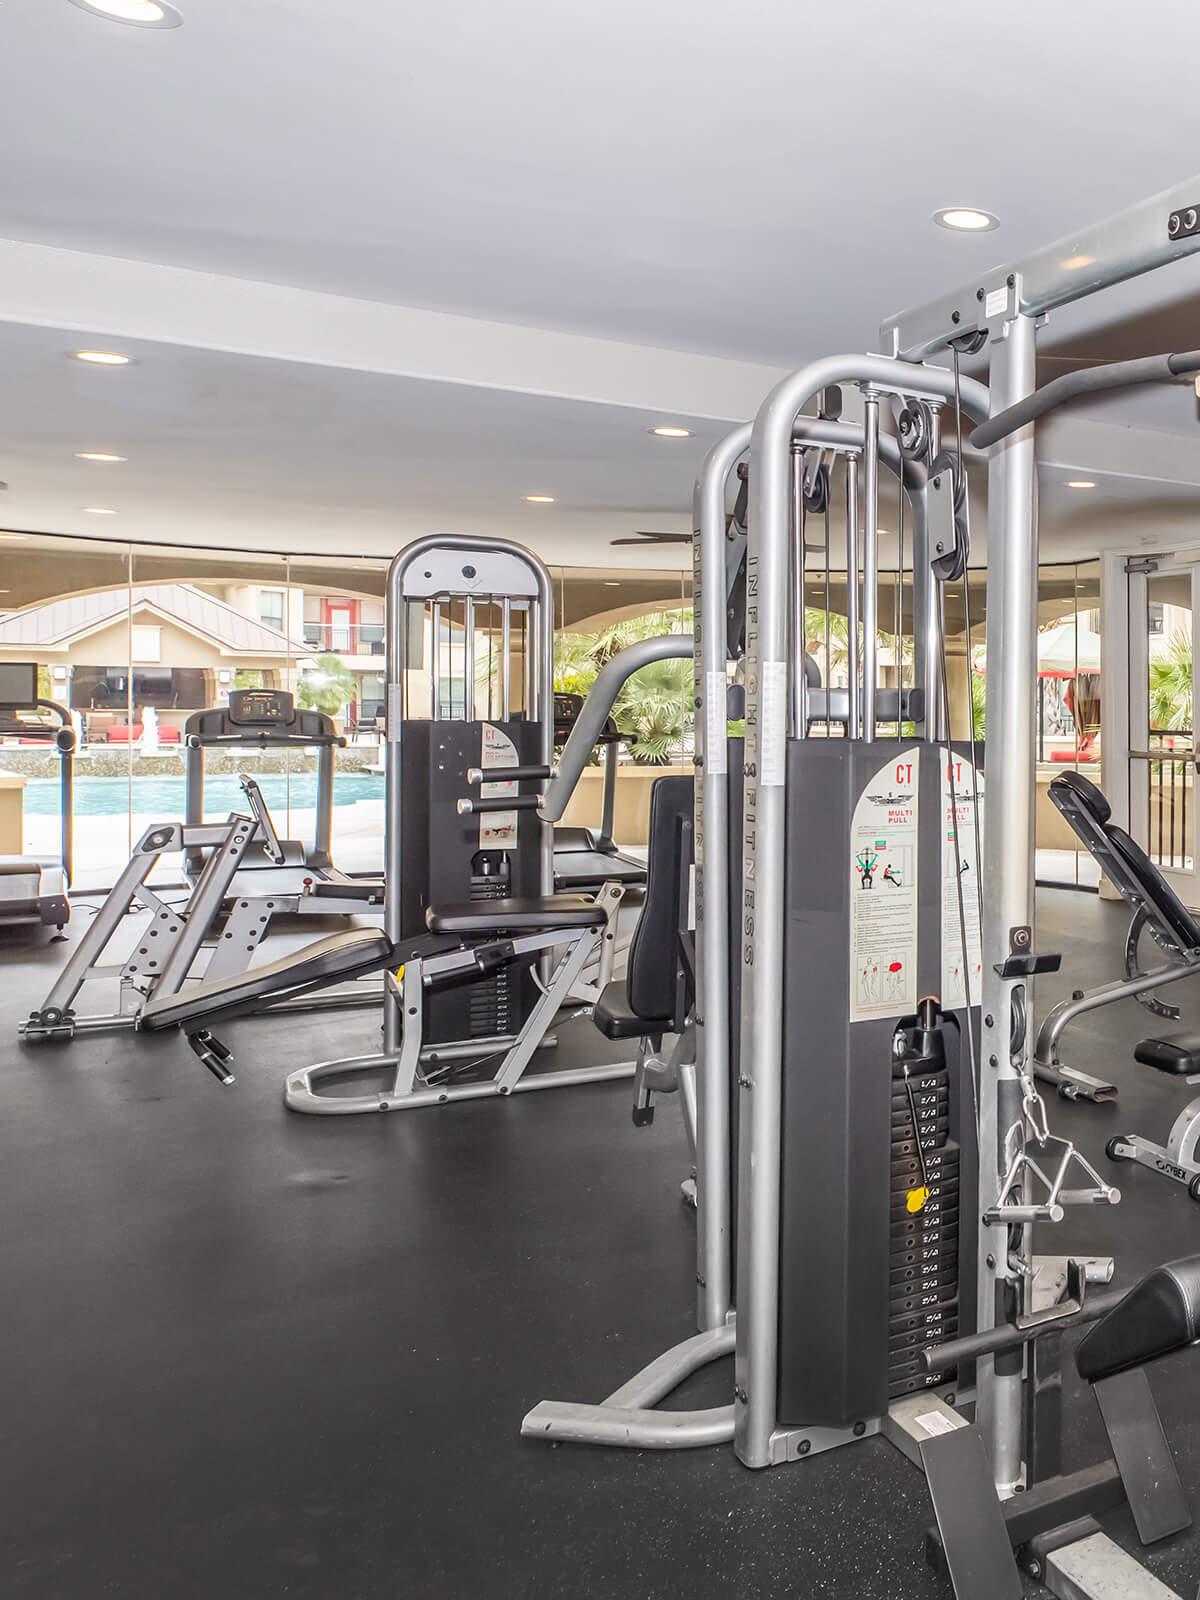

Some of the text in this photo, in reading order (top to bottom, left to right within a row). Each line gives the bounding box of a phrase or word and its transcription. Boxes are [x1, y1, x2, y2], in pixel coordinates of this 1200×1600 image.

[743, 556, 759, 966] INFLIGHT FITNESS
[896, 764, 913, 785] CT
[888, 809, 913, 817] MULTI
